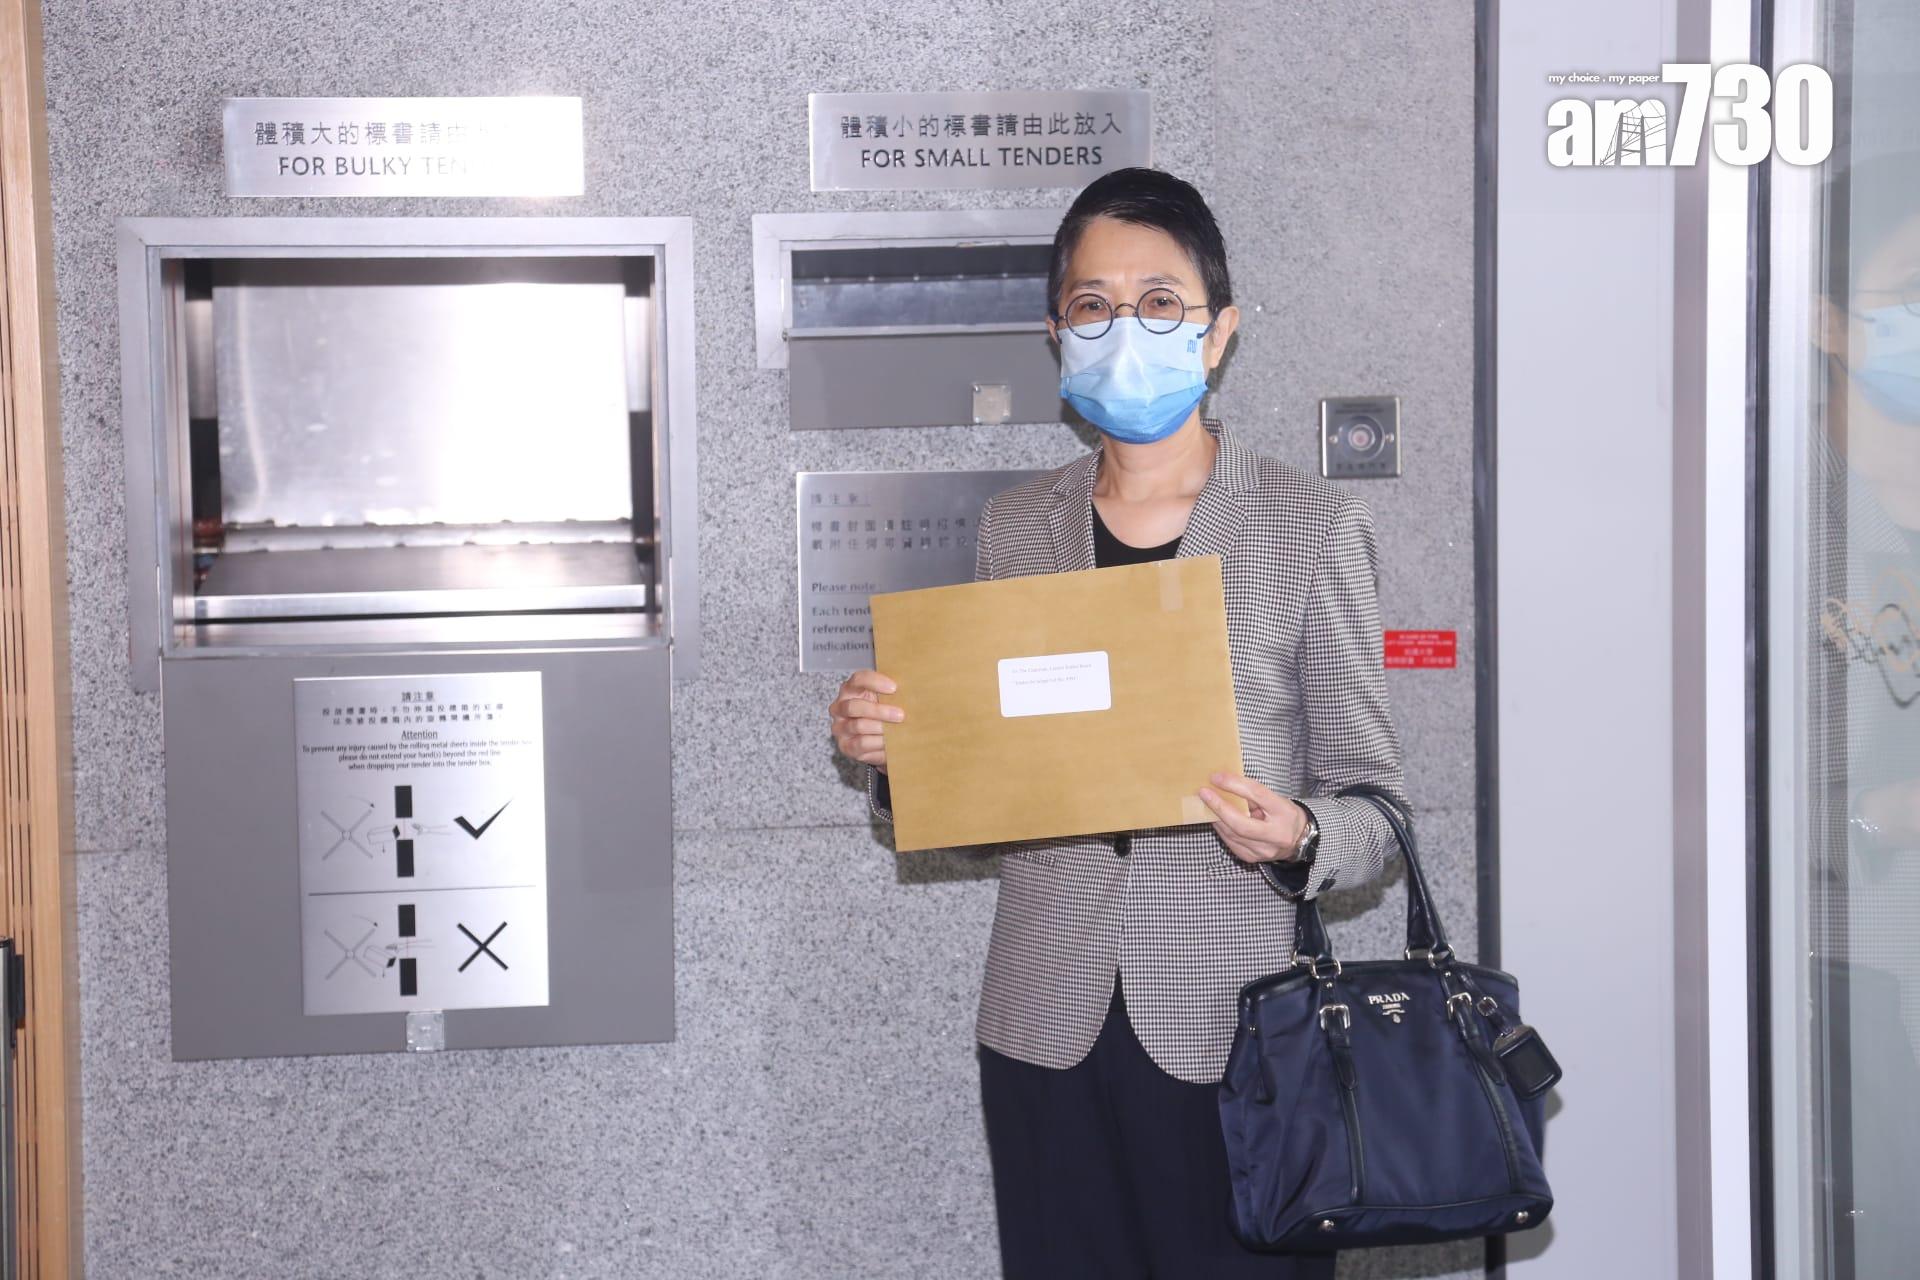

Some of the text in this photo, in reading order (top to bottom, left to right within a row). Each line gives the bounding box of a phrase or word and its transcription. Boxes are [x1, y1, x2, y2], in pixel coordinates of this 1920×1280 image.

[840, 111, 1122, 139] 體積小的標書請由此放入
[254, 121, 490, 146] 體積大的標書請由
[861, 146, 1103, 169] FOR SMALL TENDERS
[278, 155, 475, 176] FOR BULKY TEN
[843, 606, 871, 616] tend
[812, 624, 865, 634] reference
[812, 640, 870, 651] indication
[401, 730, 438, 740] Attention
[389, 742, 397, 753] by
[398, 742, 409, 750] the
[431, 740, 448, 748] metal
[1368, 992, 1411, 1005] PRADA
